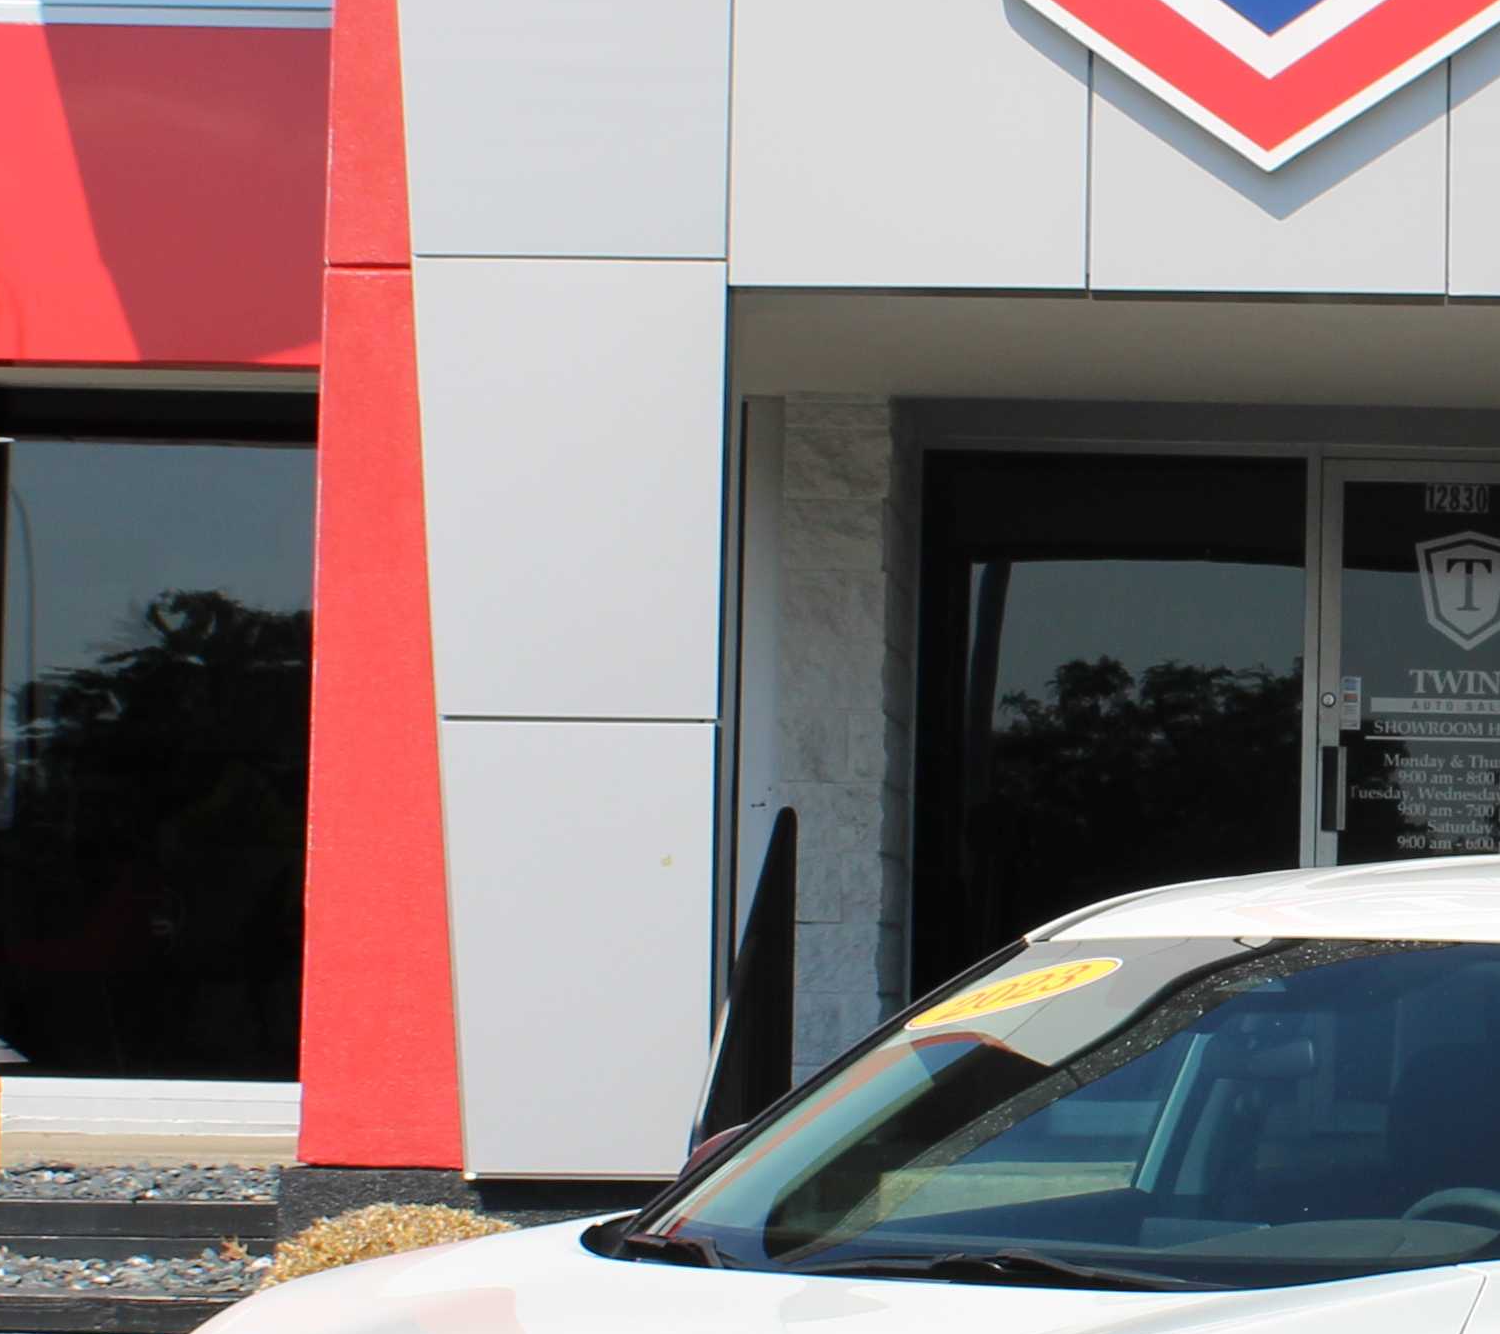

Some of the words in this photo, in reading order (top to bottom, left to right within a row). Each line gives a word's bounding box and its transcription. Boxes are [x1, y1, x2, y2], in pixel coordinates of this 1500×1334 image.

[1427, 485, 1488, 511] 12830
[1446, 558, 1492, 611] T
[1411, 700, 1454, 712] AUTO
[1374, 720, 1483, 736] SHOWROOM
[1384, 754, 1446, 771] Monday
[1451, 755, 1464, 767] &
[1398, 770, 1427, 784] 9:00
[1430, 773, 1453, 784] am
[1466, 771, 1495, 784] 8:00
[1397, 803, 1426, 816] 9:00
[1429, 805, 1453, 817] am
[1466, 804, 1495, 817] 7:00
[1428, 820, 1494, 836] Saturday
[1396, 835, 1426, 849] 9:00
[1429, 838, 1453, 849] am
[1465, 837, 1494, 850] 6:00
[931, 964, 1092, 1021] 2023
